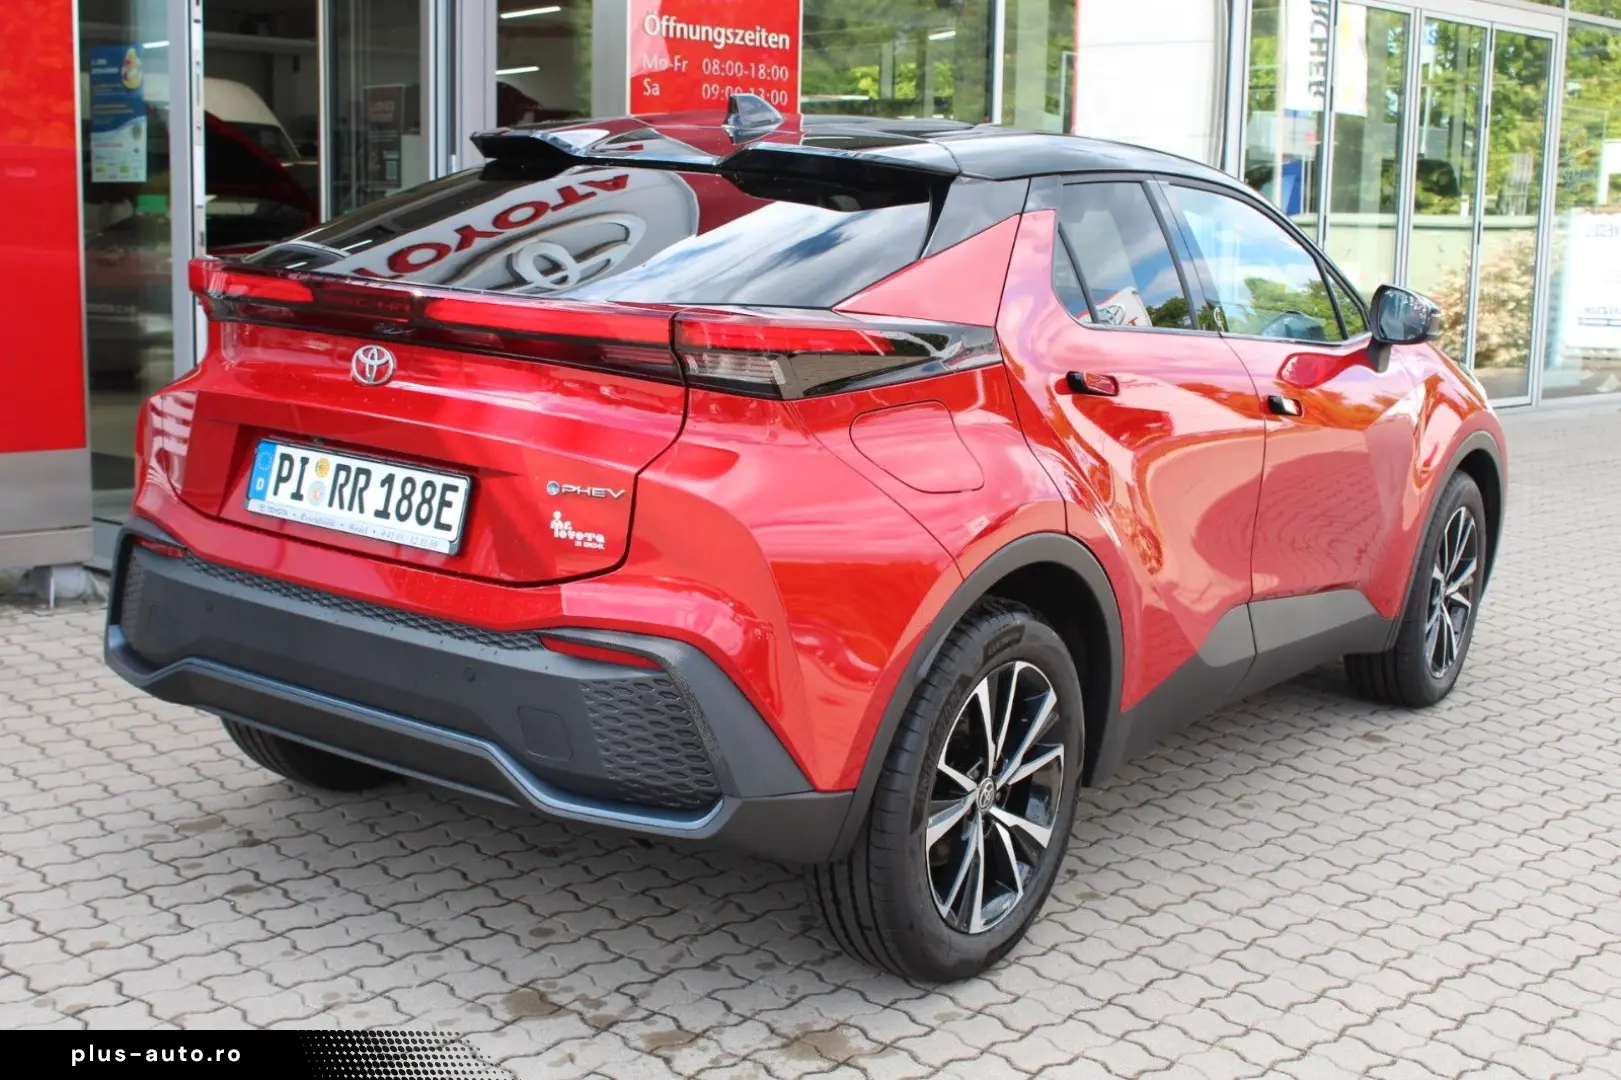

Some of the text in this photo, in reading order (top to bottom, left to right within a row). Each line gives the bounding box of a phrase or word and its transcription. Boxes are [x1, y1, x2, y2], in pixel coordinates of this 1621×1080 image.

[644, 12, 790, 49] Öffnungszeiten
[642, 54, 788, 82] Mo-Fr 08:00-18:00
[643, 78, 788, 106] Sa 09:03:00
[255, 477, 265, 491] D
[273, 452, 459, 531] PI RR 188E
[561, 484, 626, 499] PHEV
